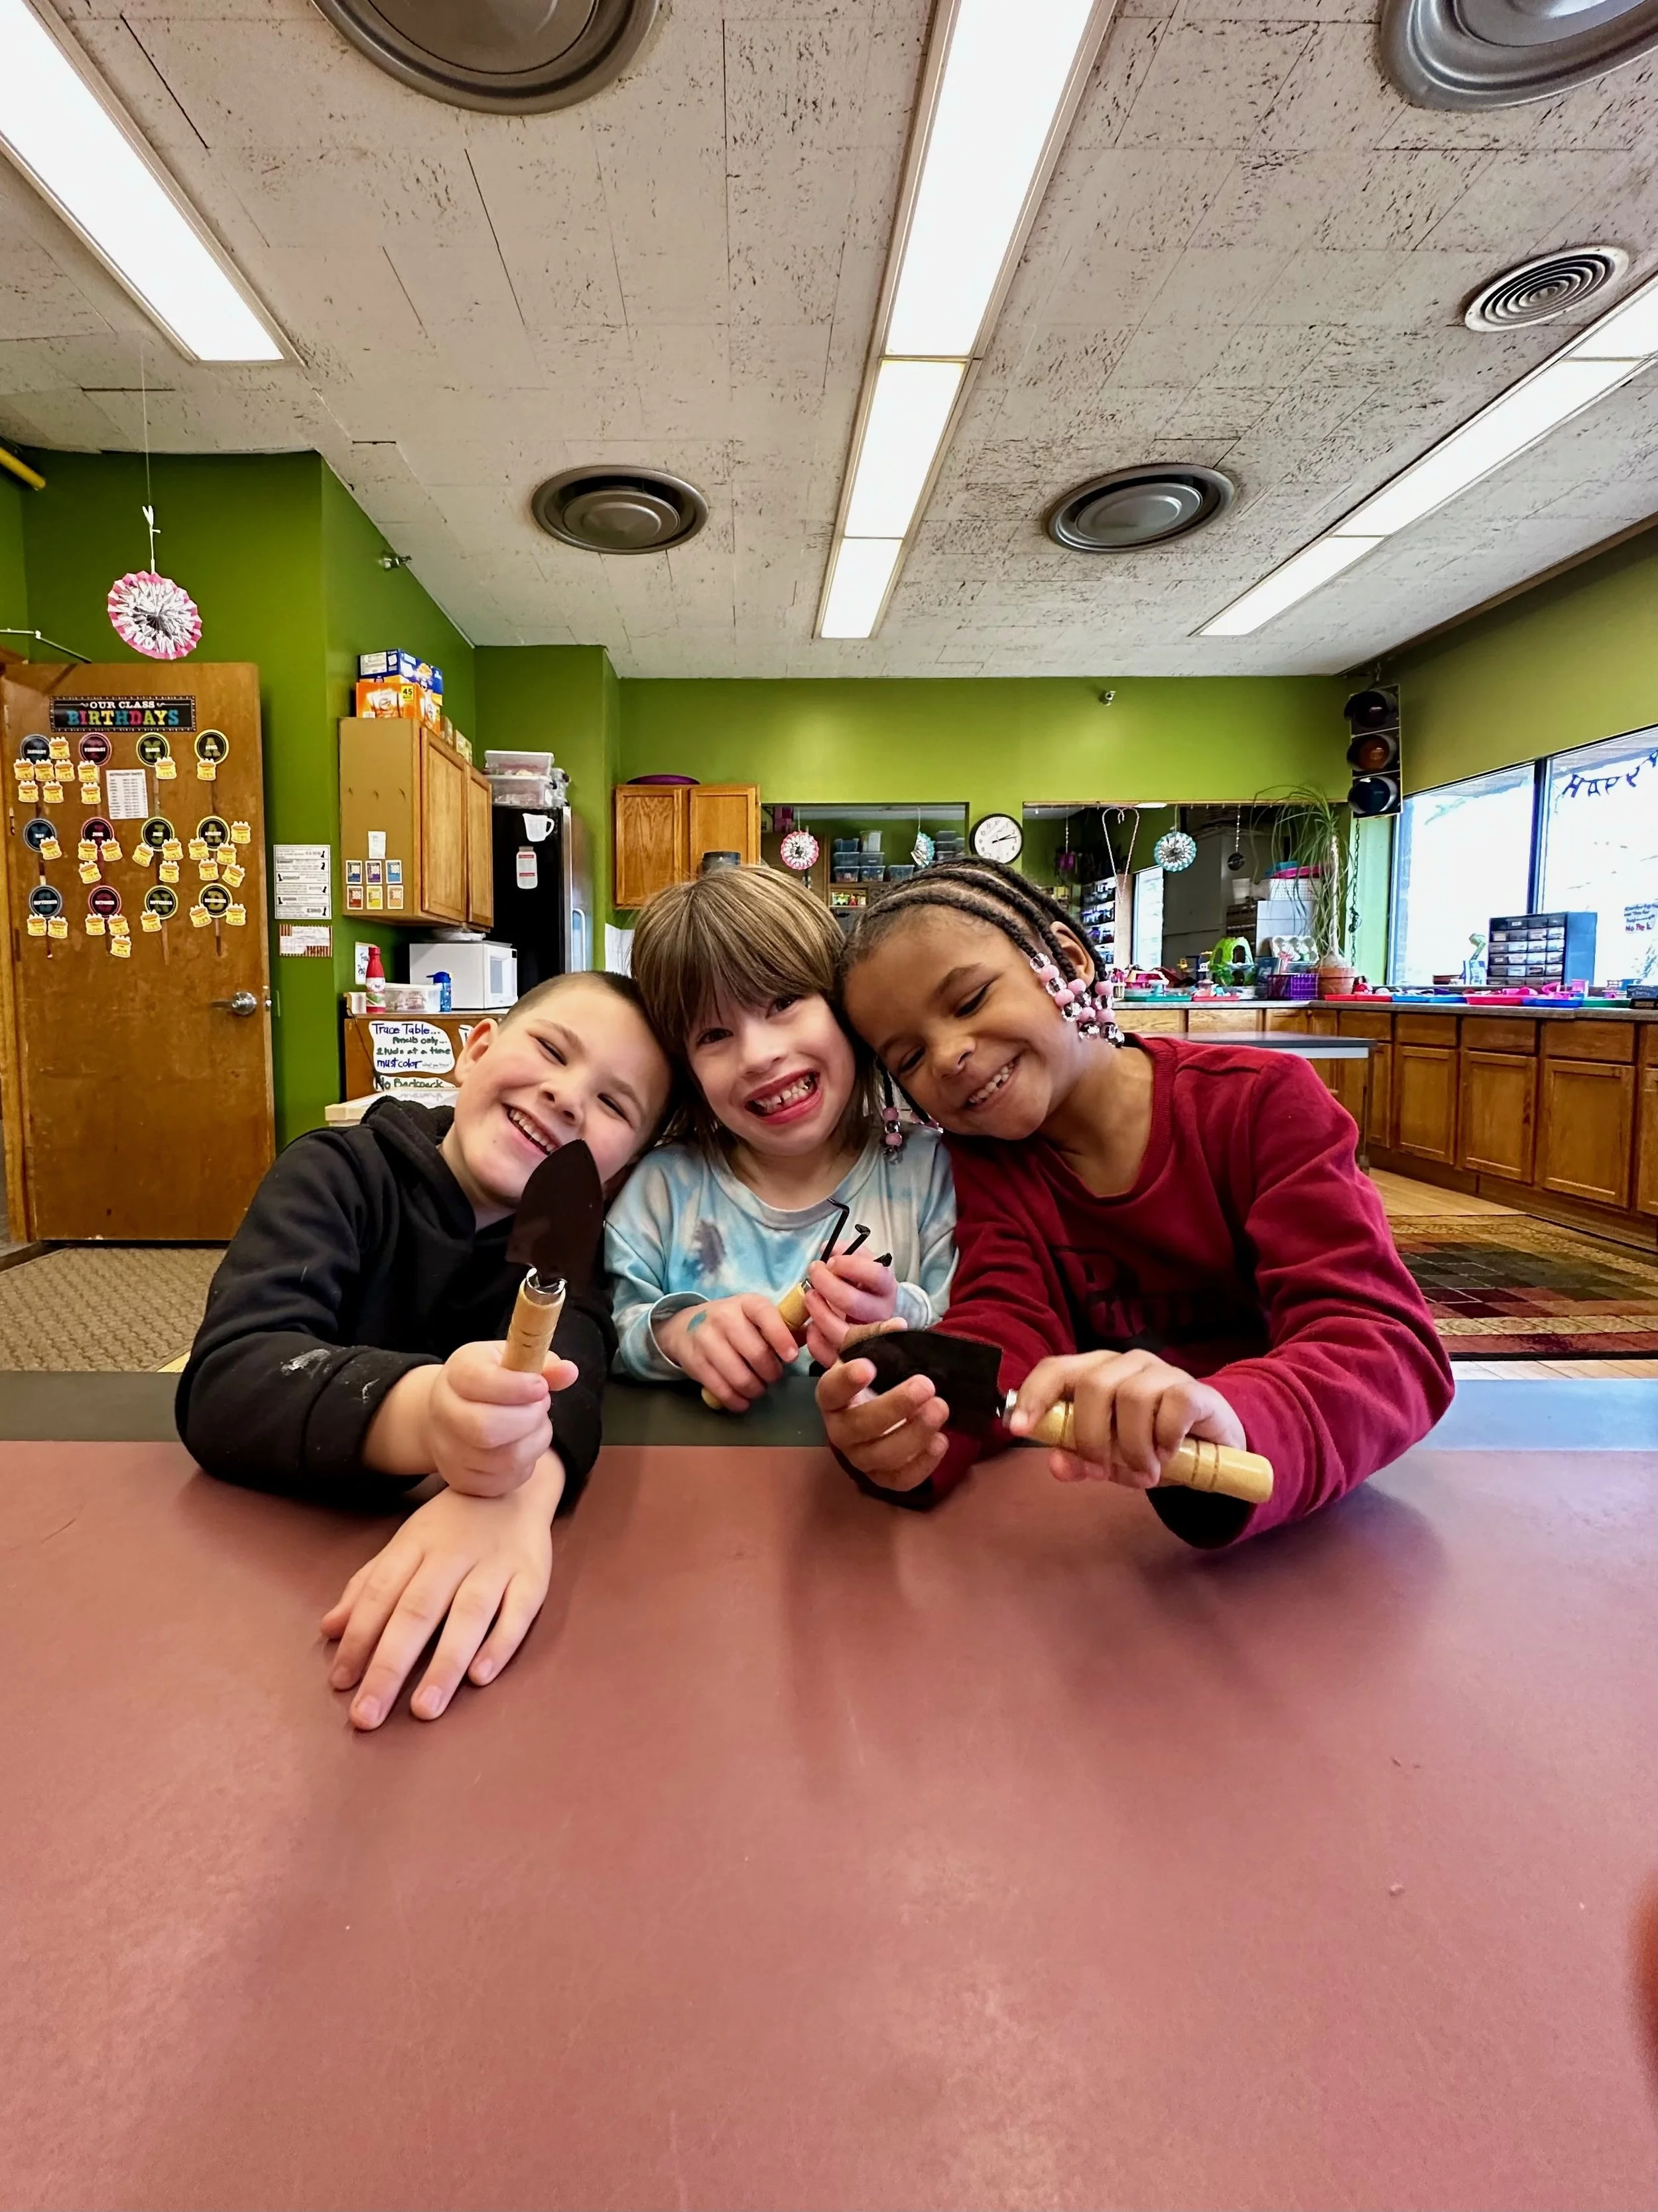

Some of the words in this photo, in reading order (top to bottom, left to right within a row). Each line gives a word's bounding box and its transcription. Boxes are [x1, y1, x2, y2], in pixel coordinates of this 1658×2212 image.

[66, 710, 179, 726] BIRTHDAYS
[371, 1023, 400, 1035] Trace
[377, 1057, 398, 1069] must
[398, 1058, 422, 1069] color
